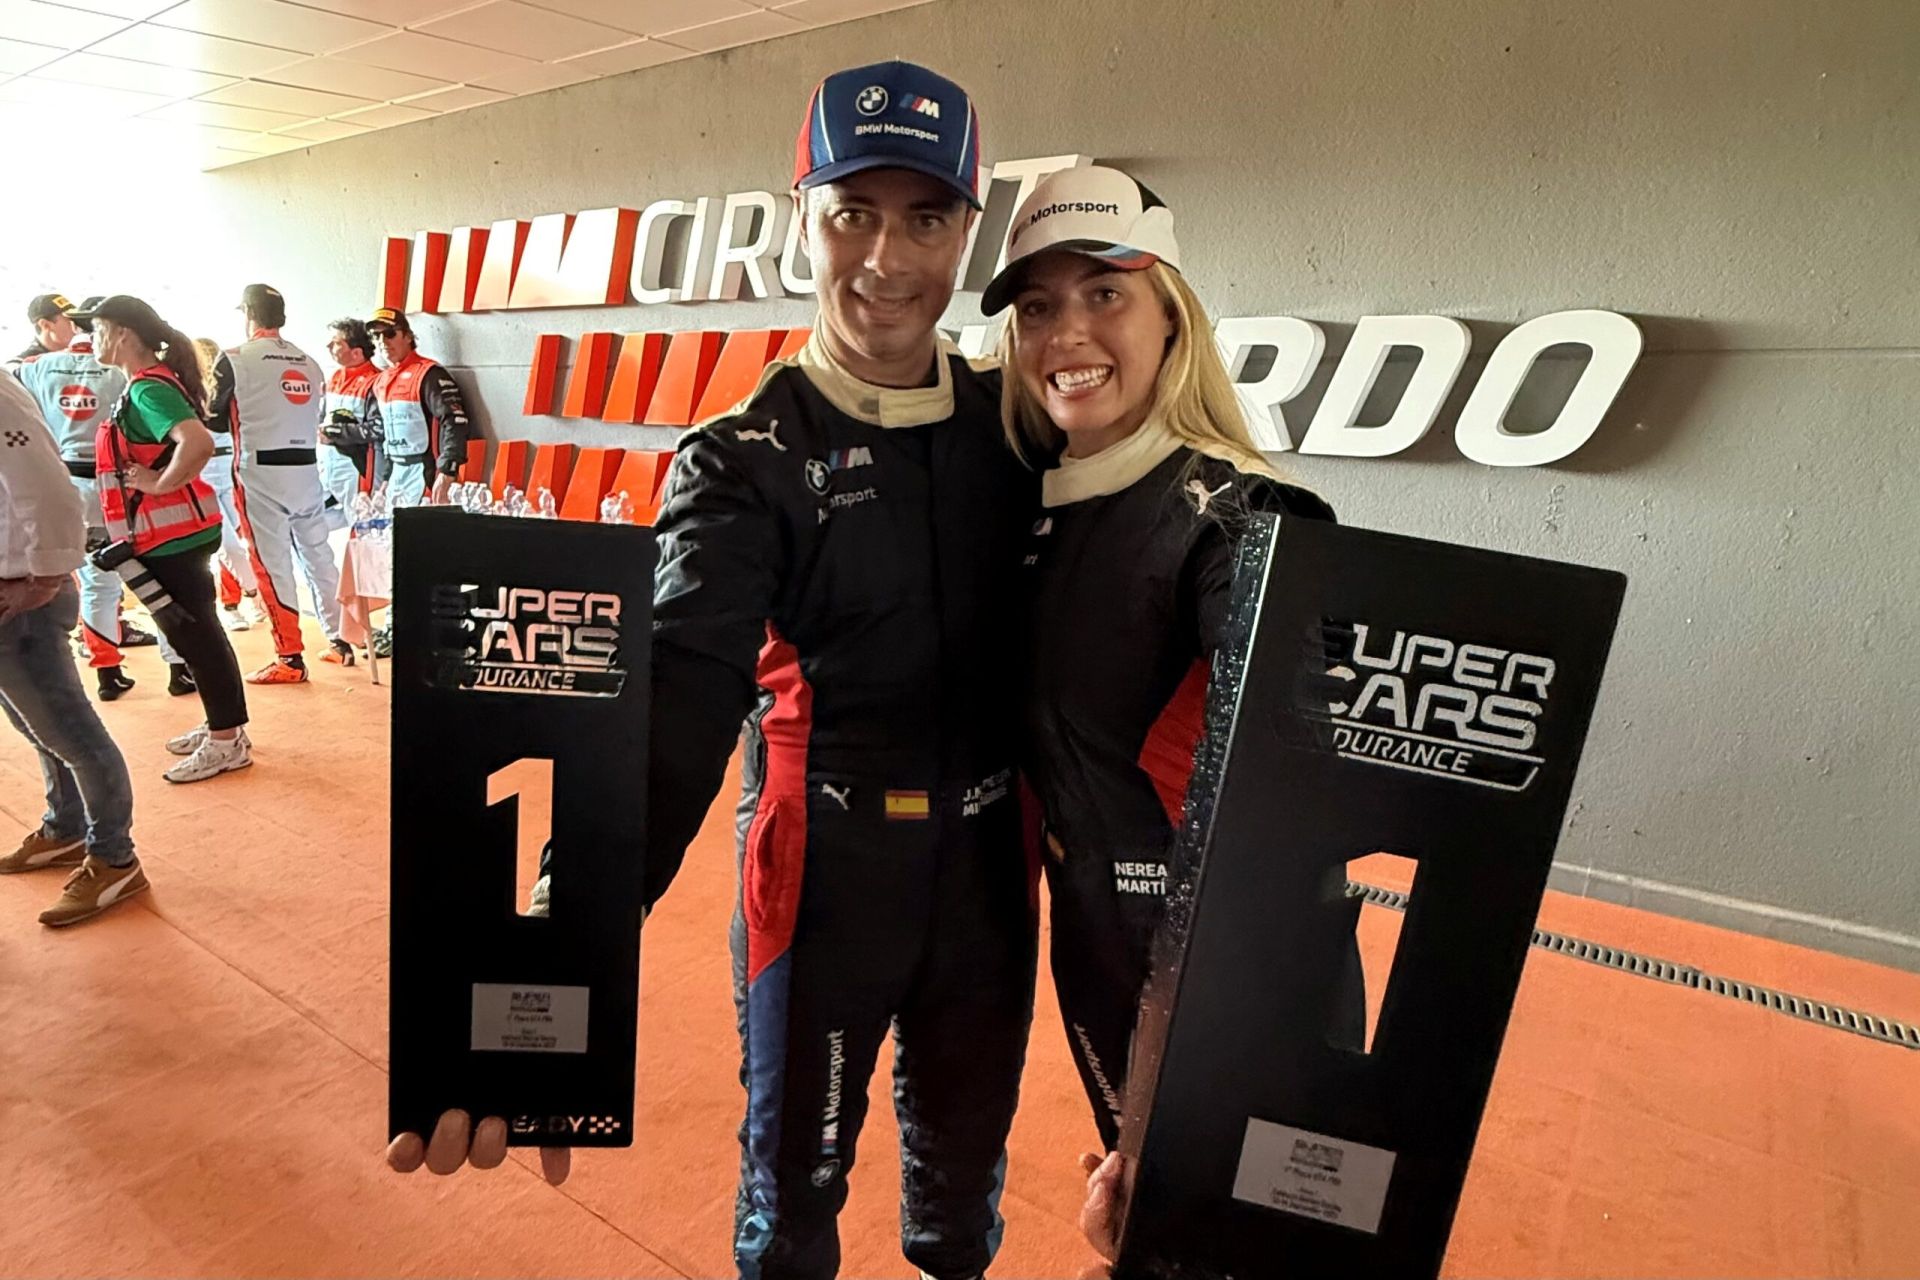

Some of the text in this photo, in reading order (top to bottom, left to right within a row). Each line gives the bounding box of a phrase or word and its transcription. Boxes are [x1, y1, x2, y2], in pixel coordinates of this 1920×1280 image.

[855, 123, 939, 142] BMW Motorsport
[1030, 202, 1119, 226] Motorsport
[59, 396, 97, 408] Gulf
[281, 381, 311, 393] Gulf
[460, 584, 621, 625] UPER
[1352, 623, 1556, 699] UPER
[1332, 727, 1474, 774] DURANCE
[486, 757, 554, 918] 1
[1114, 861, 1168, 877] NEREA
[1116, 877, 1166, 895] MARTÍ
[1346, 852, 1418, 1054] 1
[823, 1028, 845, 1121] Motorsport
